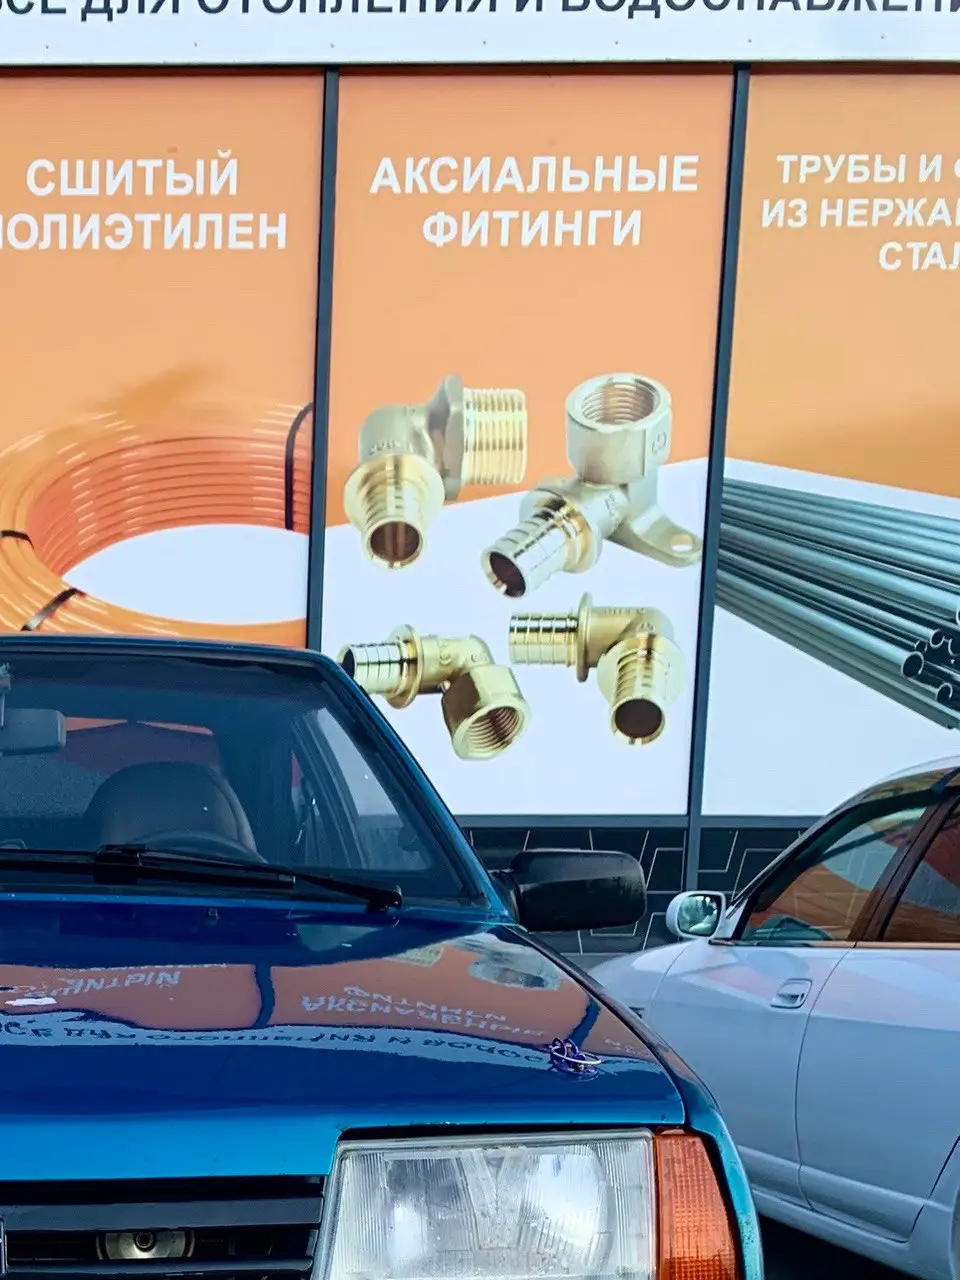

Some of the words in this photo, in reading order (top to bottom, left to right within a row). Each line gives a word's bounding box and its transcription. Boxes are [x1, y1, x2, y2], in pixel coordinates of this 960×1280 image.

[26, 149, 238, 196] СШИТЫЙ
[369, 155, 699, 194] АКСИАЛЬНЫЕ
[776, 153, 907, 184] ТРУБЫ
[918, 153, 943, 183] И
[422, 209, 642, 248] ФИТИНГИ
[761, 198, 808, 228] ИЗ
[819, 197, 960, 228] НЕРЖА
